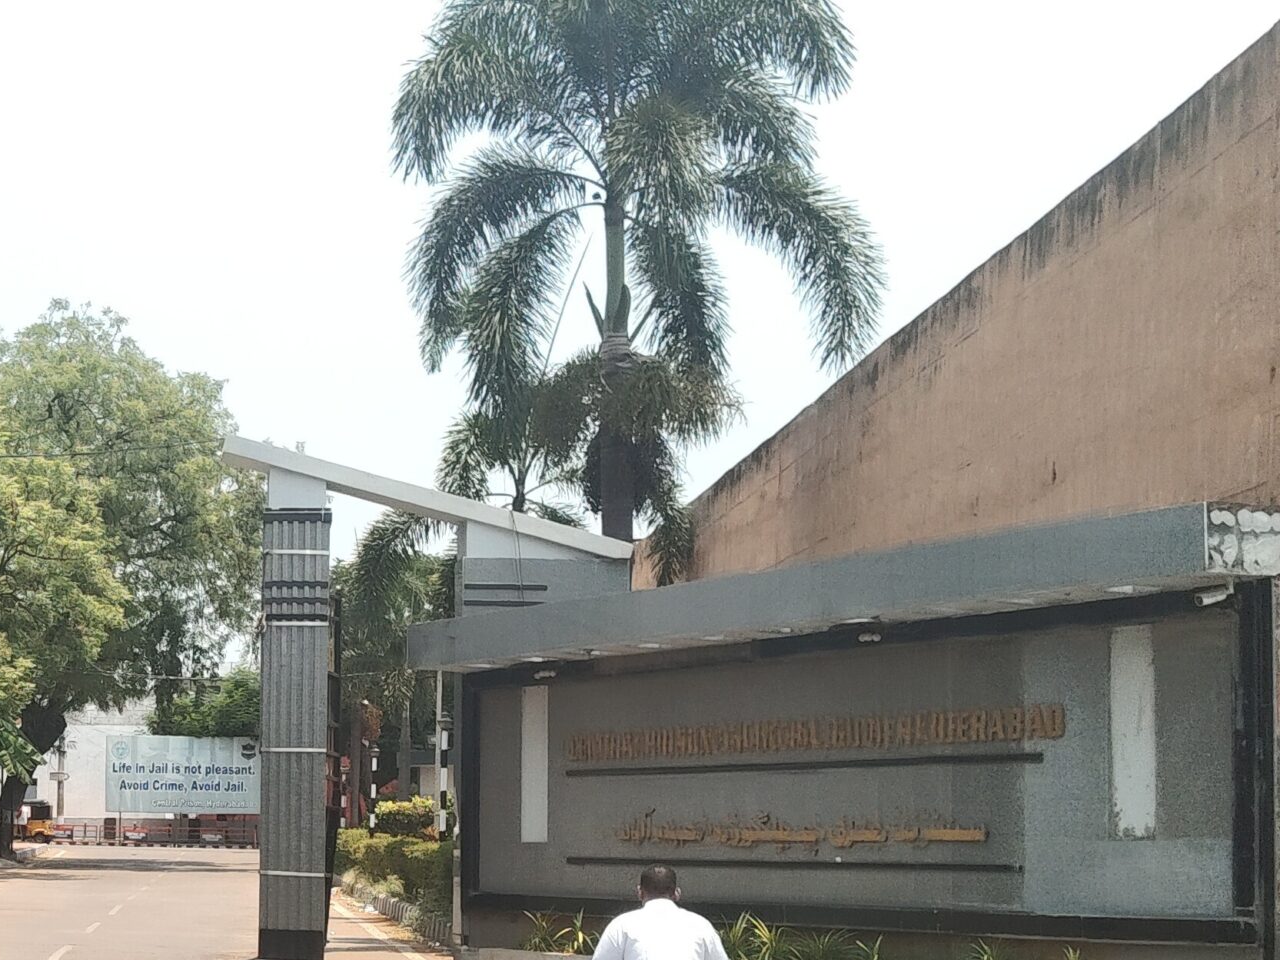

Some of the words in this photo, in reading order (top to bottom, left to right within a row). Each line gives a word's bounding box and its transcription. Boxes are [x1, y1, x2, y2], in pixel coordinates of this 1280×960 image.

[112, 762, 132, 774] Life
[149, 763, 168, 774] Jail
[172, 764, 181, 774] is
[184, 765, 202, 775] not
[205, 763, 255, 777] pleasant.
[120, 780, 149, 791] Avoid
[152, 780, 188, 794] Crime,
[191, 780, 221, 792] Avoid
[224, 781, 247, 792] Jail.
